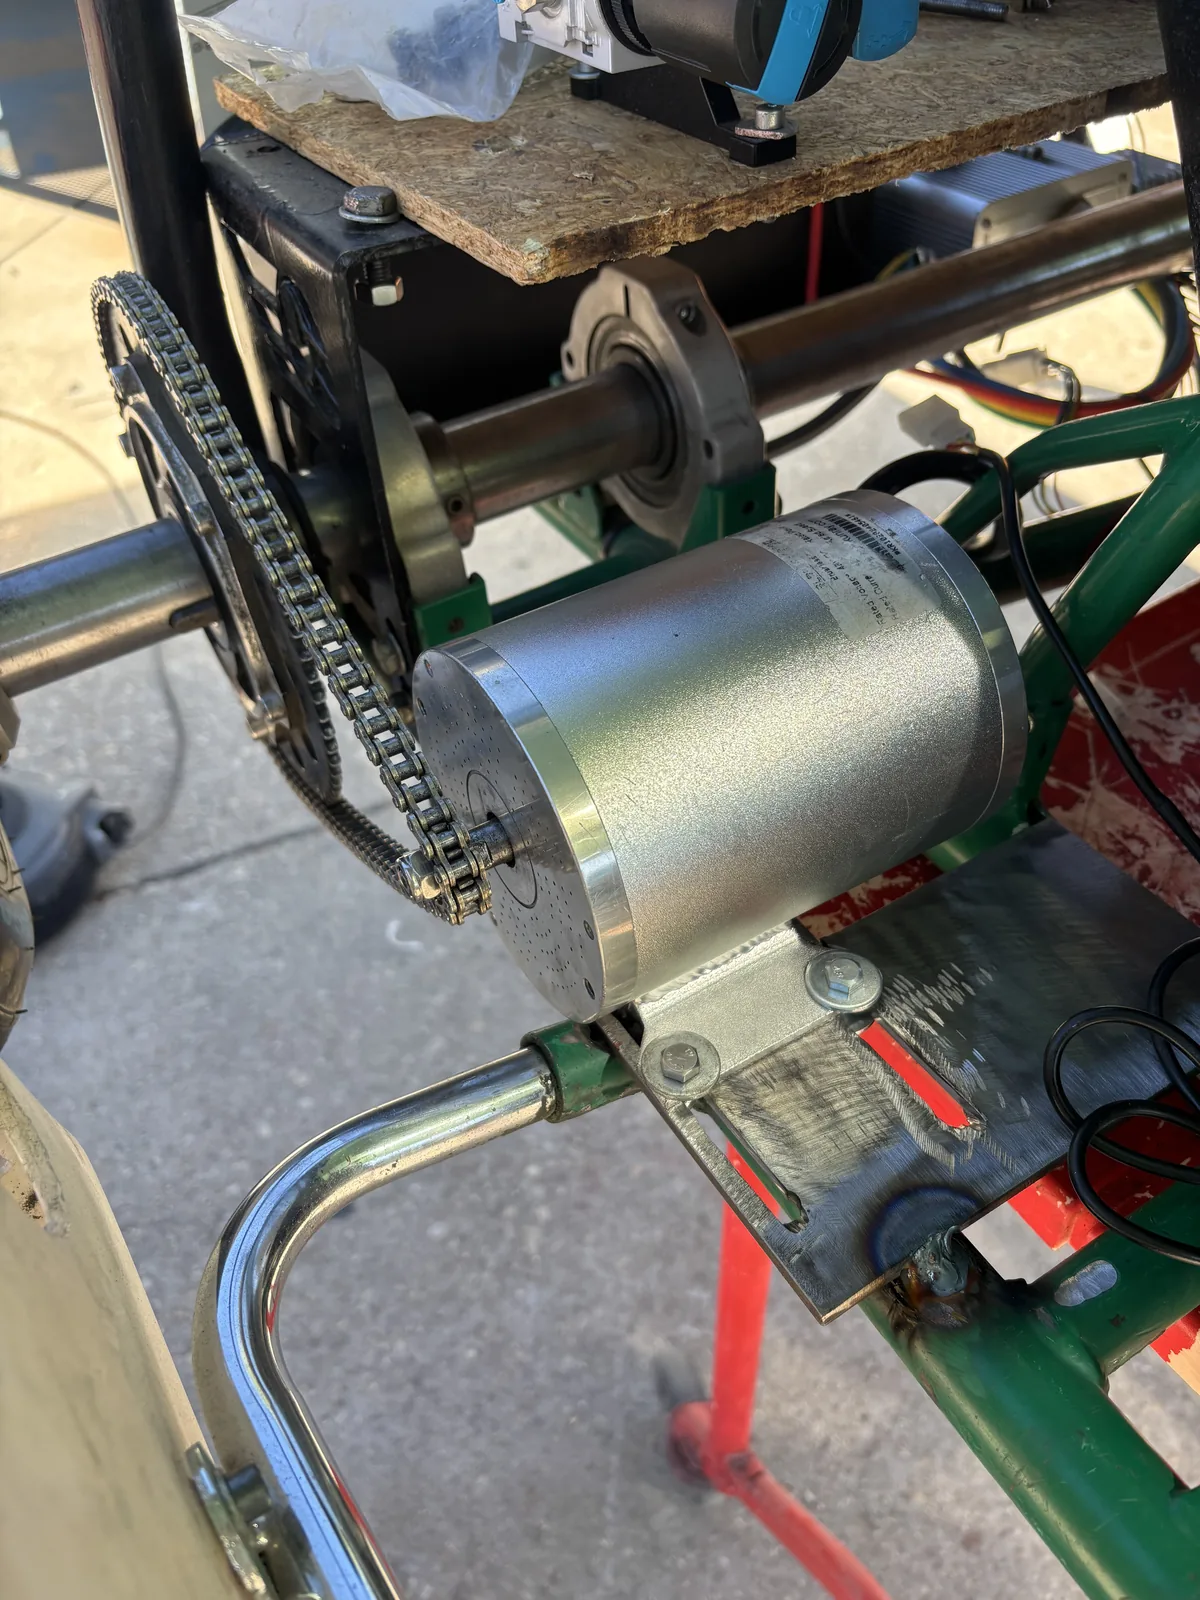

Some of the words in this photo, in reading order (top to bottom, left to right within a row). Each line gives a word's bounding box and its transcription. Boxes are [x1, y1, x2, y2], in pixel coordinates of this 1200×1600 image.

[864, 574, 882, 595] Curre
[866, 600, 886, 625] Rated
[879, 596, 898, 620] Rated
